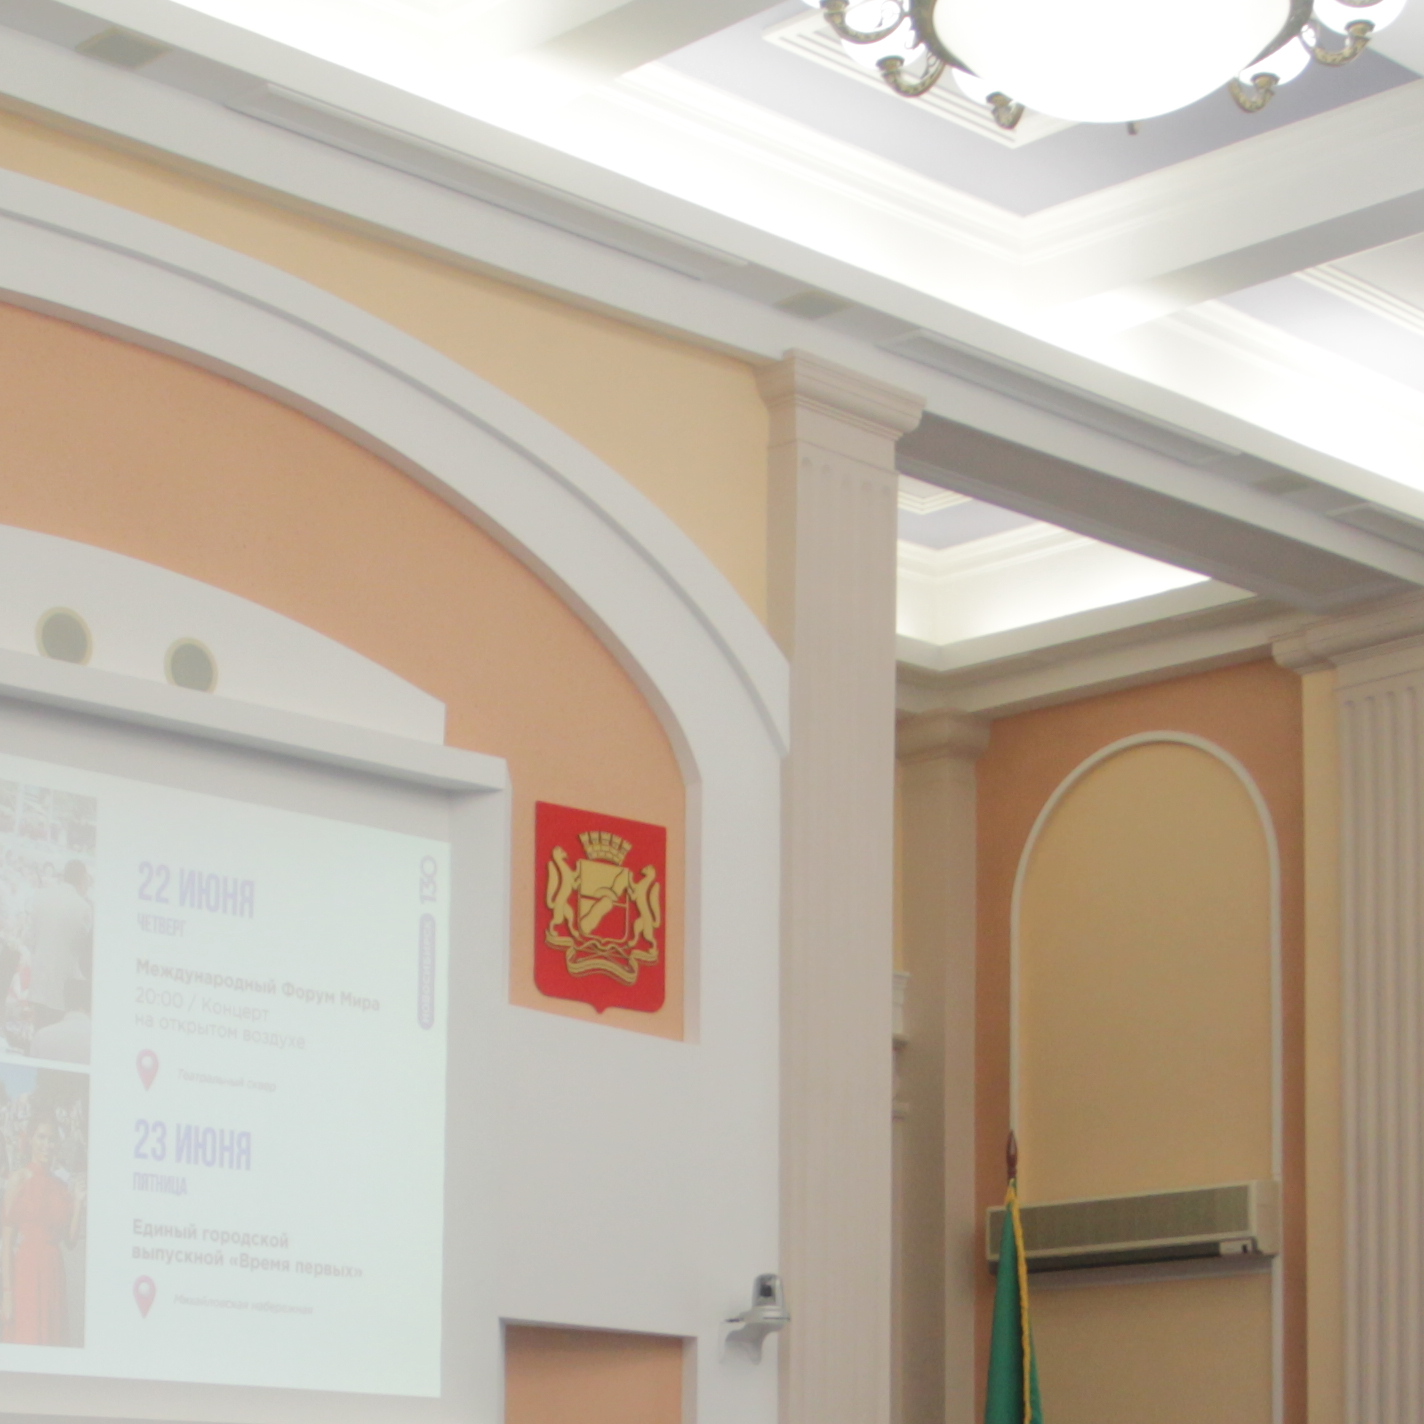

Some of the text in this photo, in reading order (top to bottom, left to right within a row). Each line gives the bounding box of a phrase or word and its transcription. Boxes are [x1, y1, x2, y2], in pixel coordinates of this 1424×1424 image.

[138, 861, 255, 919] 22 ИЮНЯ
[419, 855, 437, 906] 130
[137, 913, 187, 937] ЧЕТВЕРГ
[136, 958, 382, 1013] Международный Форум Мира
[135, 986, 184, 1009] 20:00
[201, 996, 270, 1023] Концерт
[134, 1013, 306, 1050] на открытом воздухе
[133, 1118, 252, 1171] 23 ИЮНЯ
[133, 1171, 188, 1196] ПЯТНИЦА
[133, 1218, 289, 1249] Единый городской
[132, 1245, 363, 1279] выпускной «Время первых»
